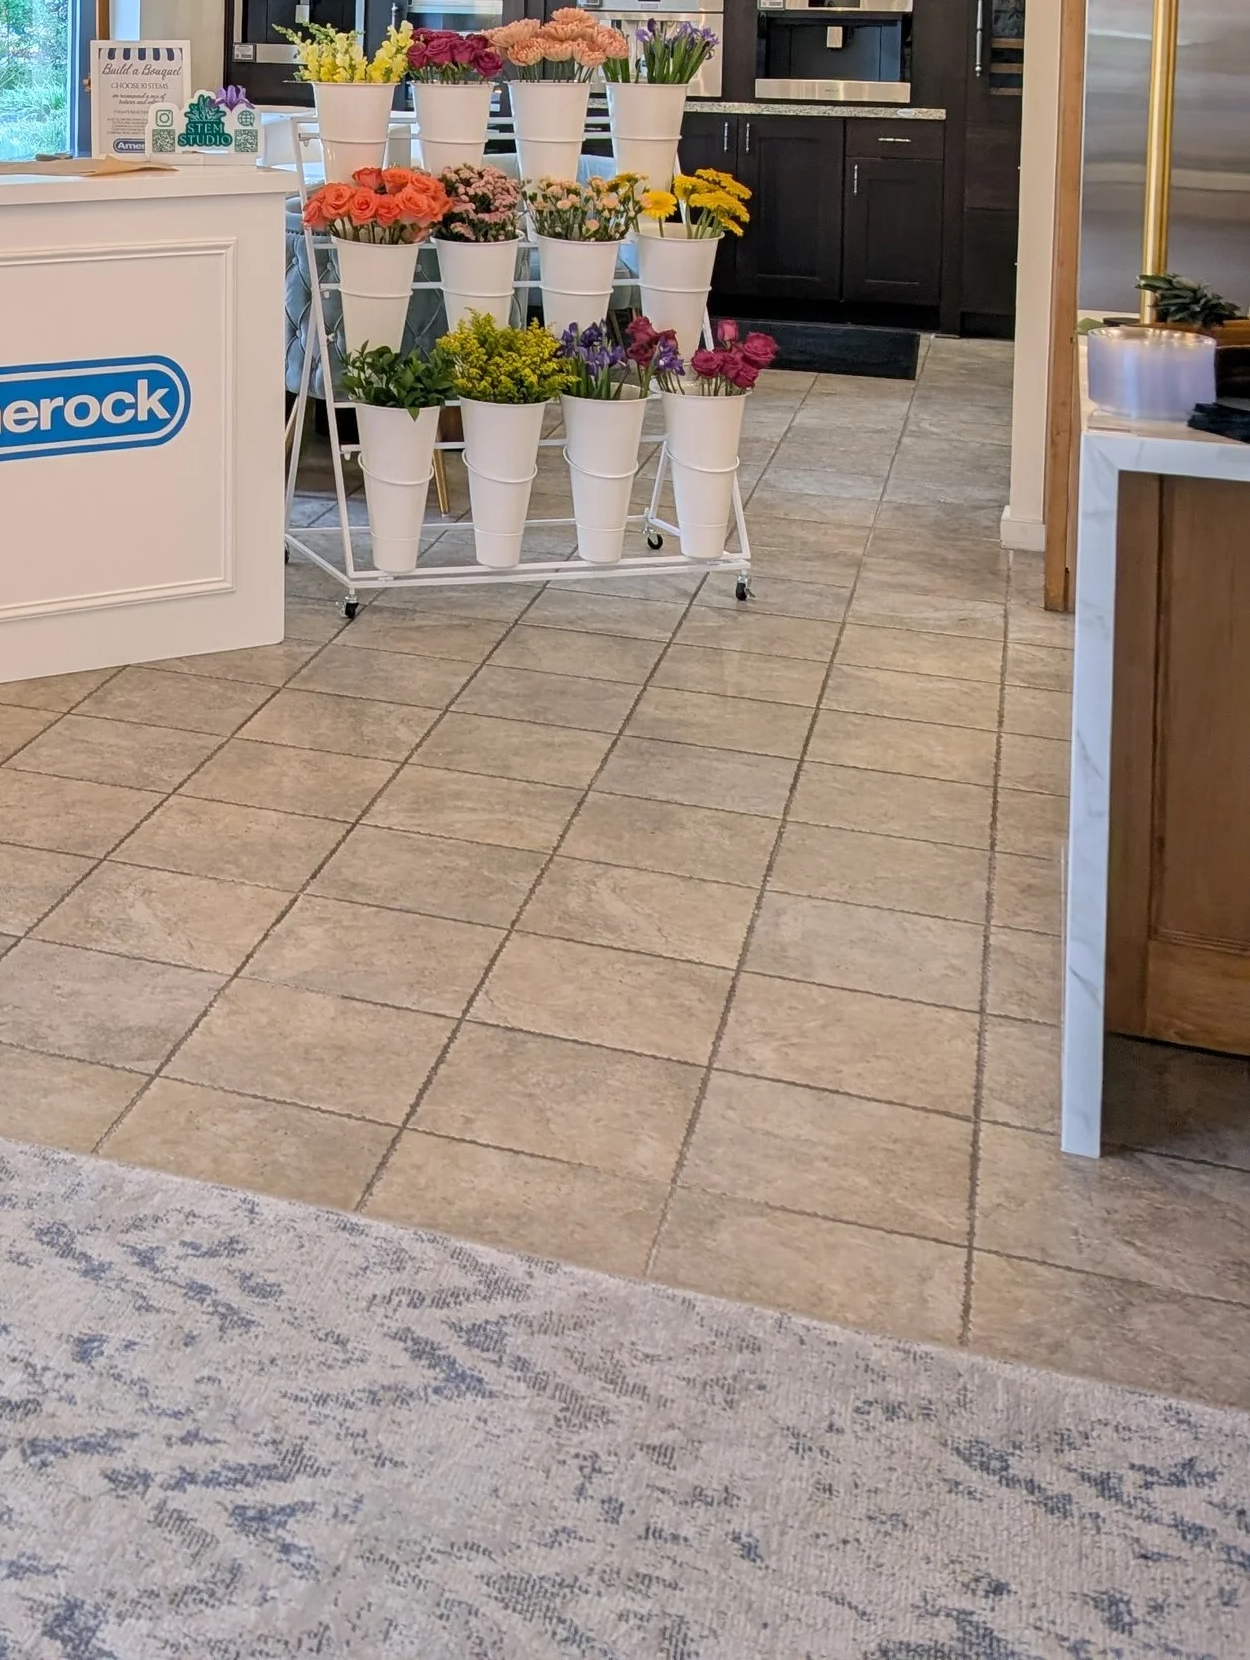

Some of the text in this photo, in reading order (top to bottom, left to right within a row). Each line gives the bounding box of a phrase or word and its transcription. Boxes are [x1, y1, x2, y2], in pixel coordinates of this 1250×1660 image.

[102, 63, 131, 76] Build
[141, 64, 182, 80] Bouquet
[111, 82, 140, 90] CHOOSE
[187, 124, 224, 134] STEM
[179, 135, 232, 147] STUDIO
